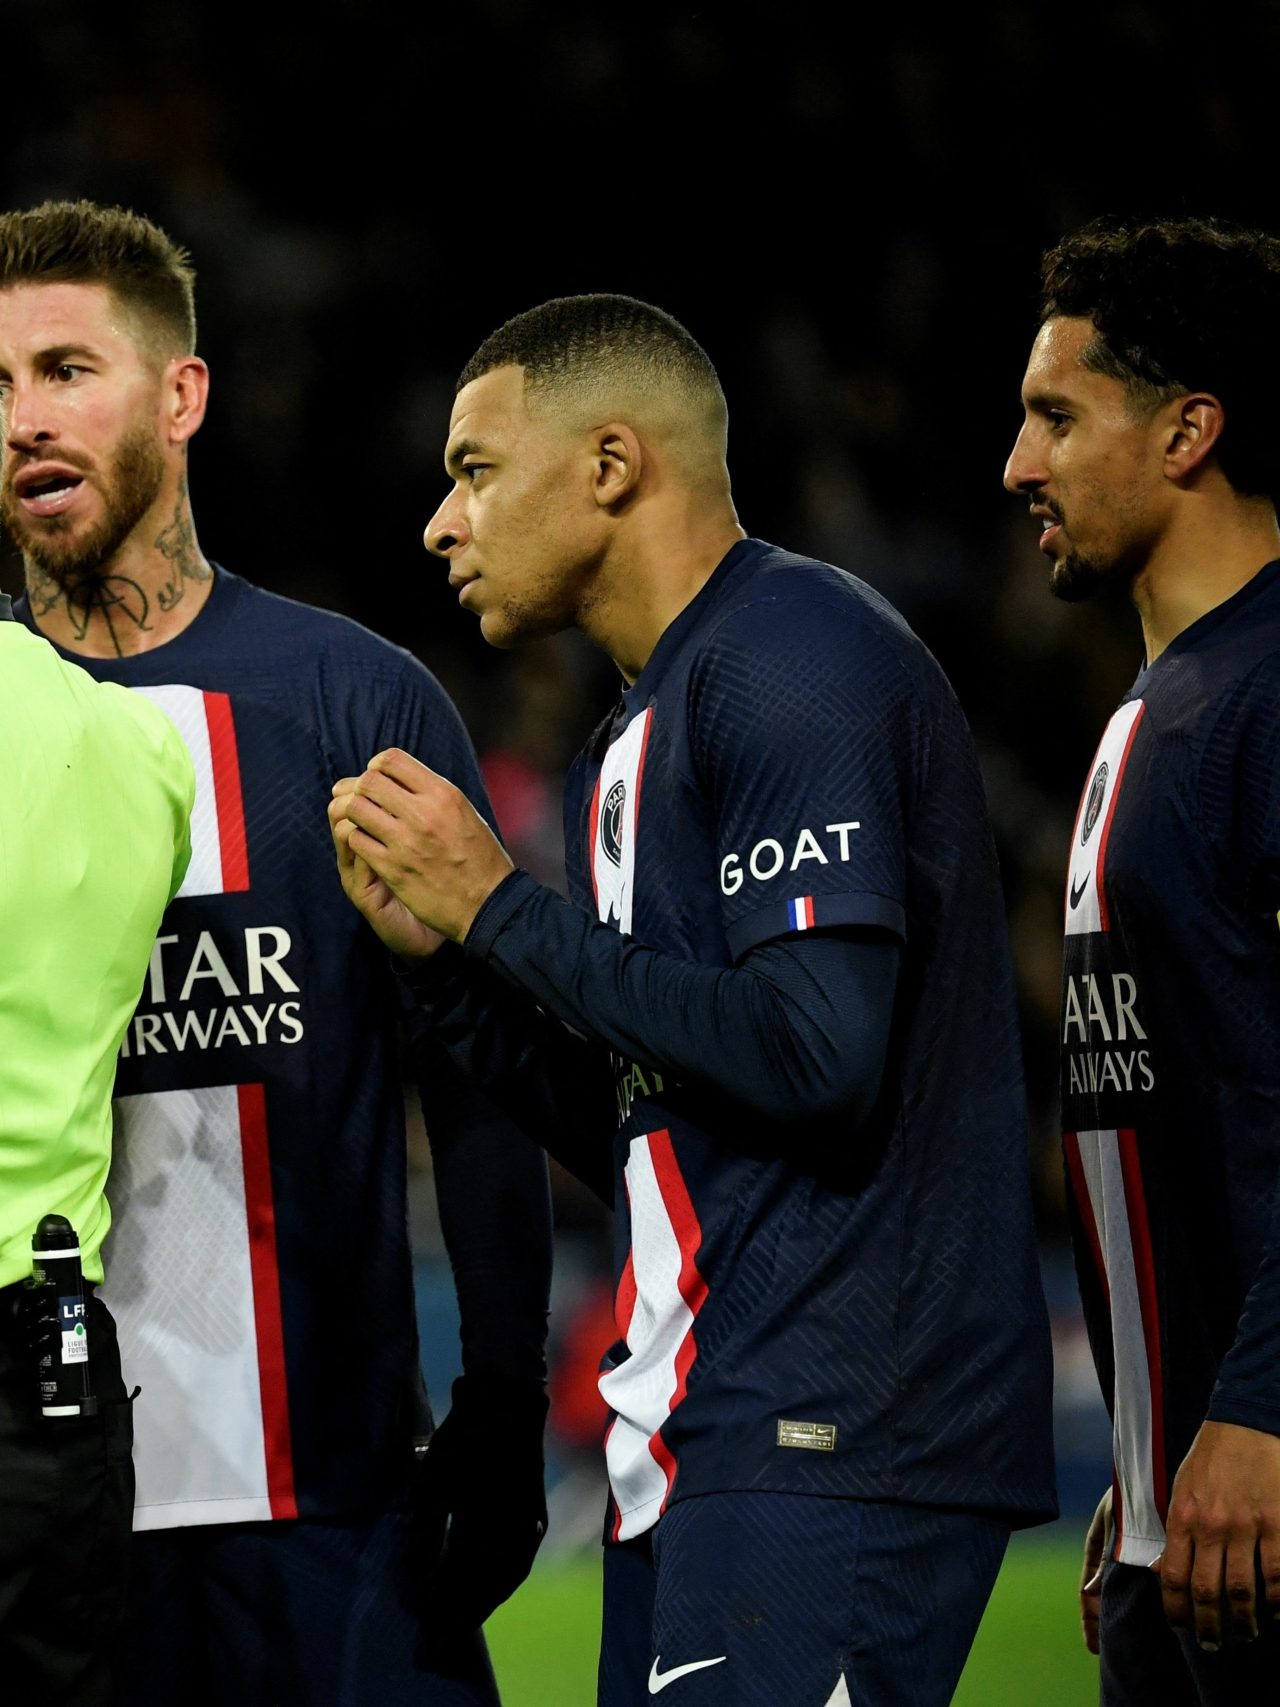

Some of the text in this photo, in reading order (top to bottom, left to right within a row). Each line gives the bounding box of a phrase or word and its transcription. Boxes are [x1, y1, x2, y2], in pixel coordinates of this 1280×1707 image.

[720, 821, 861, 896] GOAT
[149, 925, 301, 1005] TAR
[120, 1001, 304, 1058] IRWAYS
